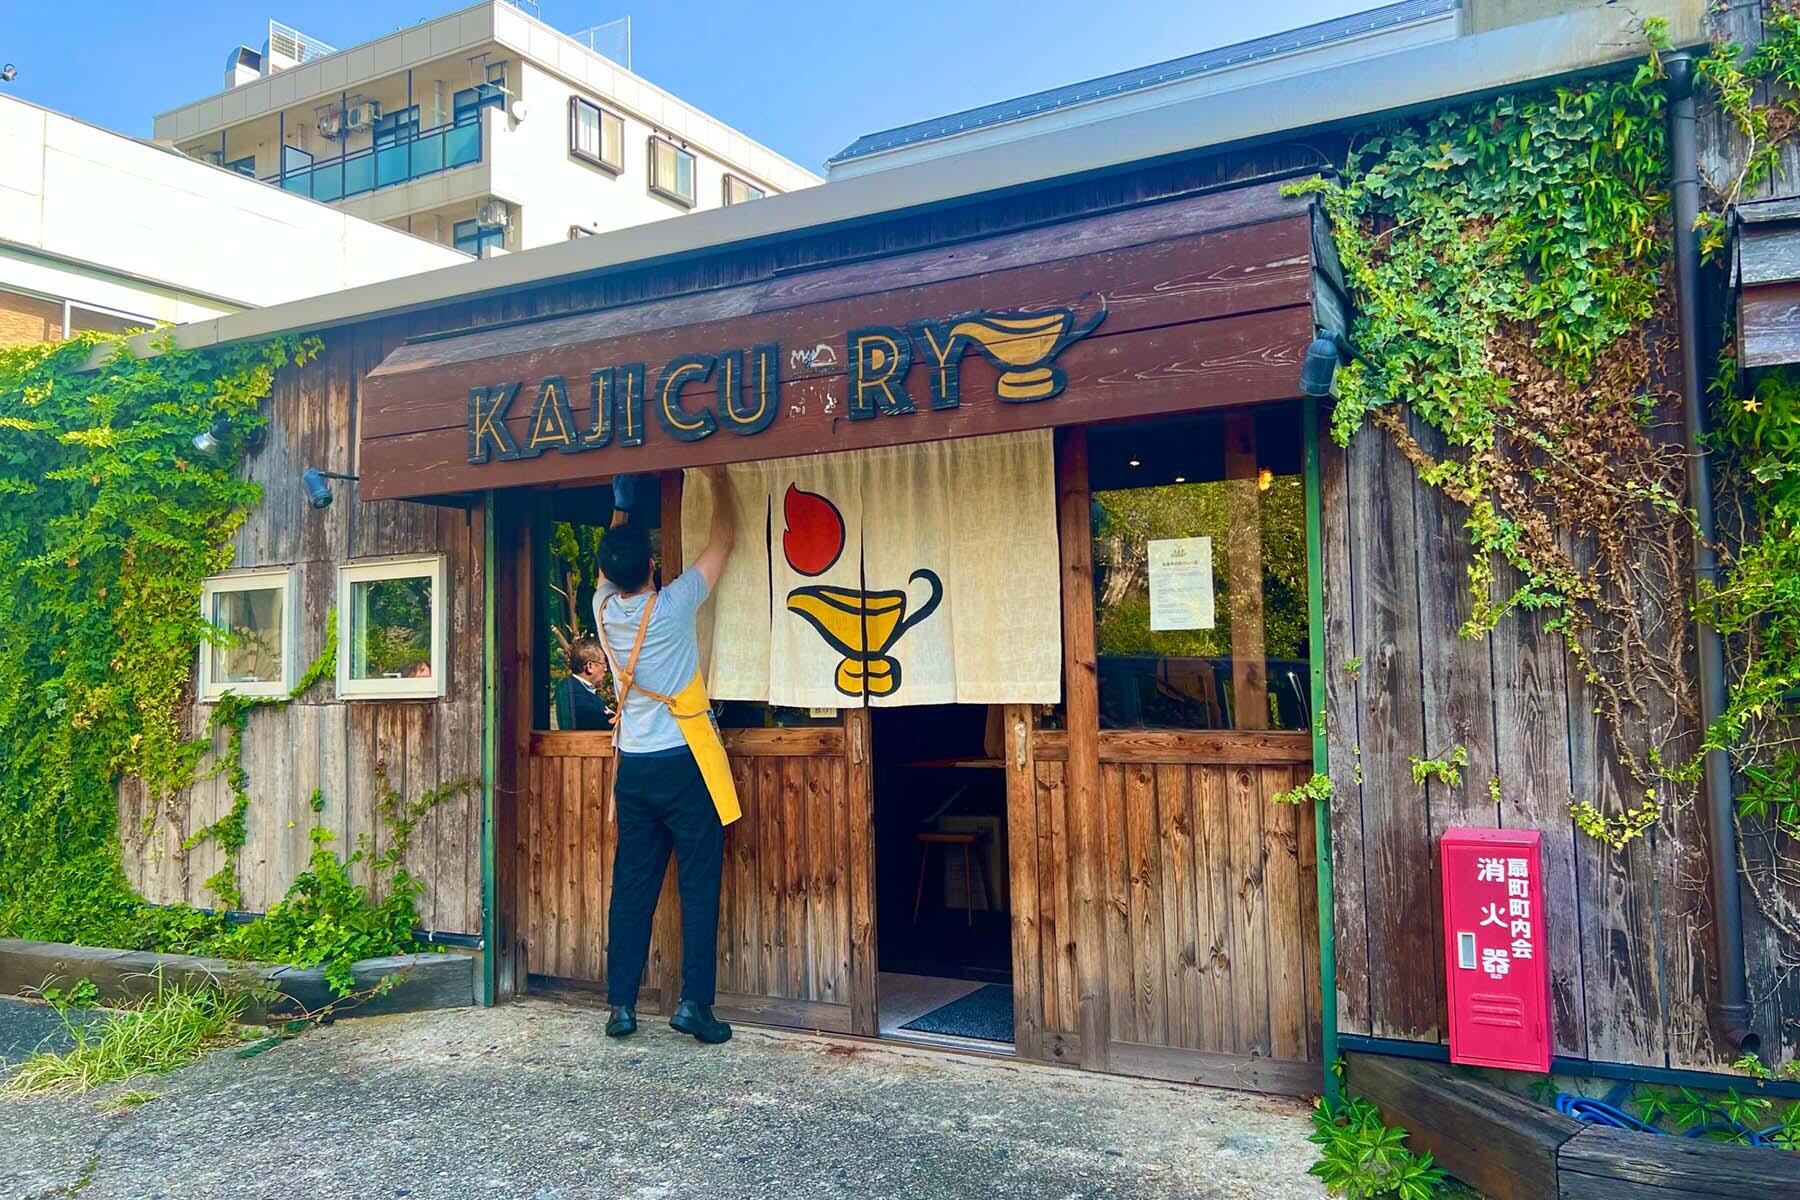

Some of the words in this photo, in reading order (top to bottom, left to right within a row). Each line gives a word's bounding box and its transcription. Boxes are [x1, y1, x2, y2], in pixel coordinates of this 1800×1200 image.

[467, 342, 781, 463] KAJICU
[1477, 857, 1510, 974] 消火器
[1507, 858, 1532, 959] 扇町町内会
